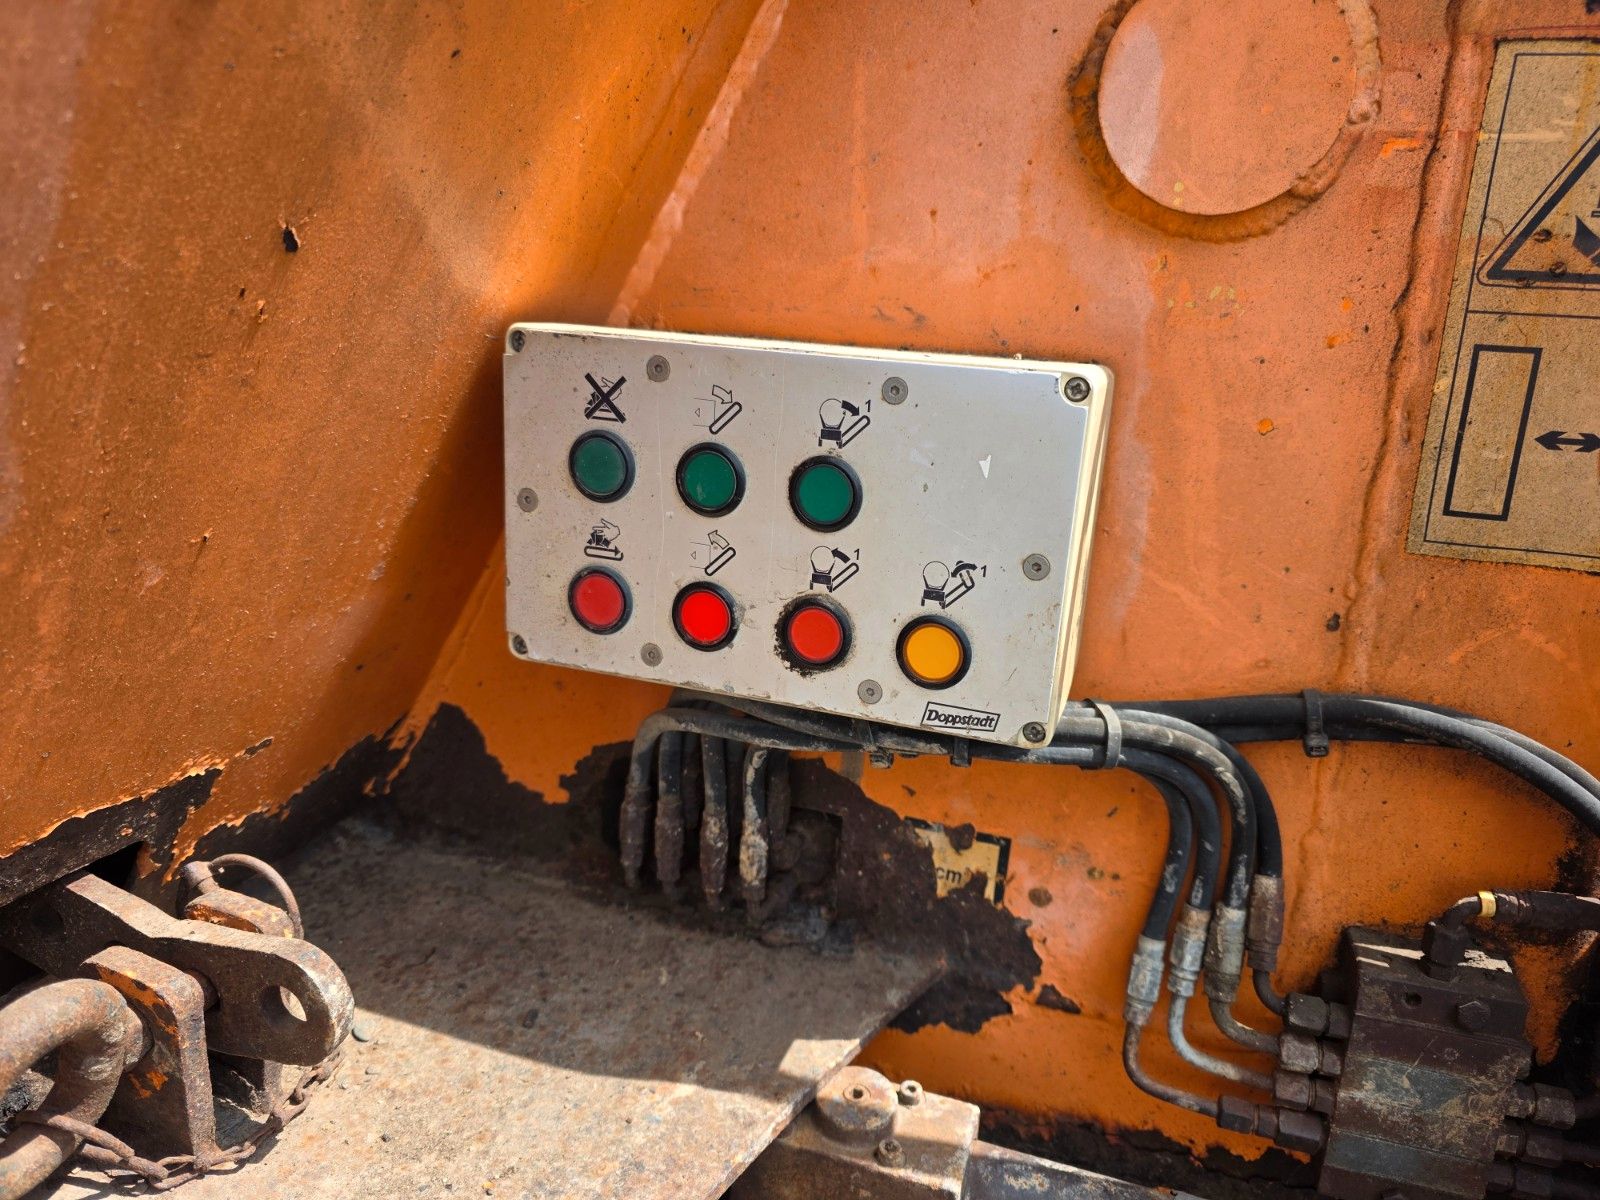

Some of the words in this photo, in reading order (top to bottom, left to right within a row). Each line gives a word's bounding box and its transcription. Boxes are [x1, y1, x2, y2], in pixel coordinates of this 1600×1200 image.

[865, 399, 871, 412] 1
[854, 548, 860, 560] 1
[981, 565, 987, 577] 1
[926, 709, 995, 728] Doppstadt
